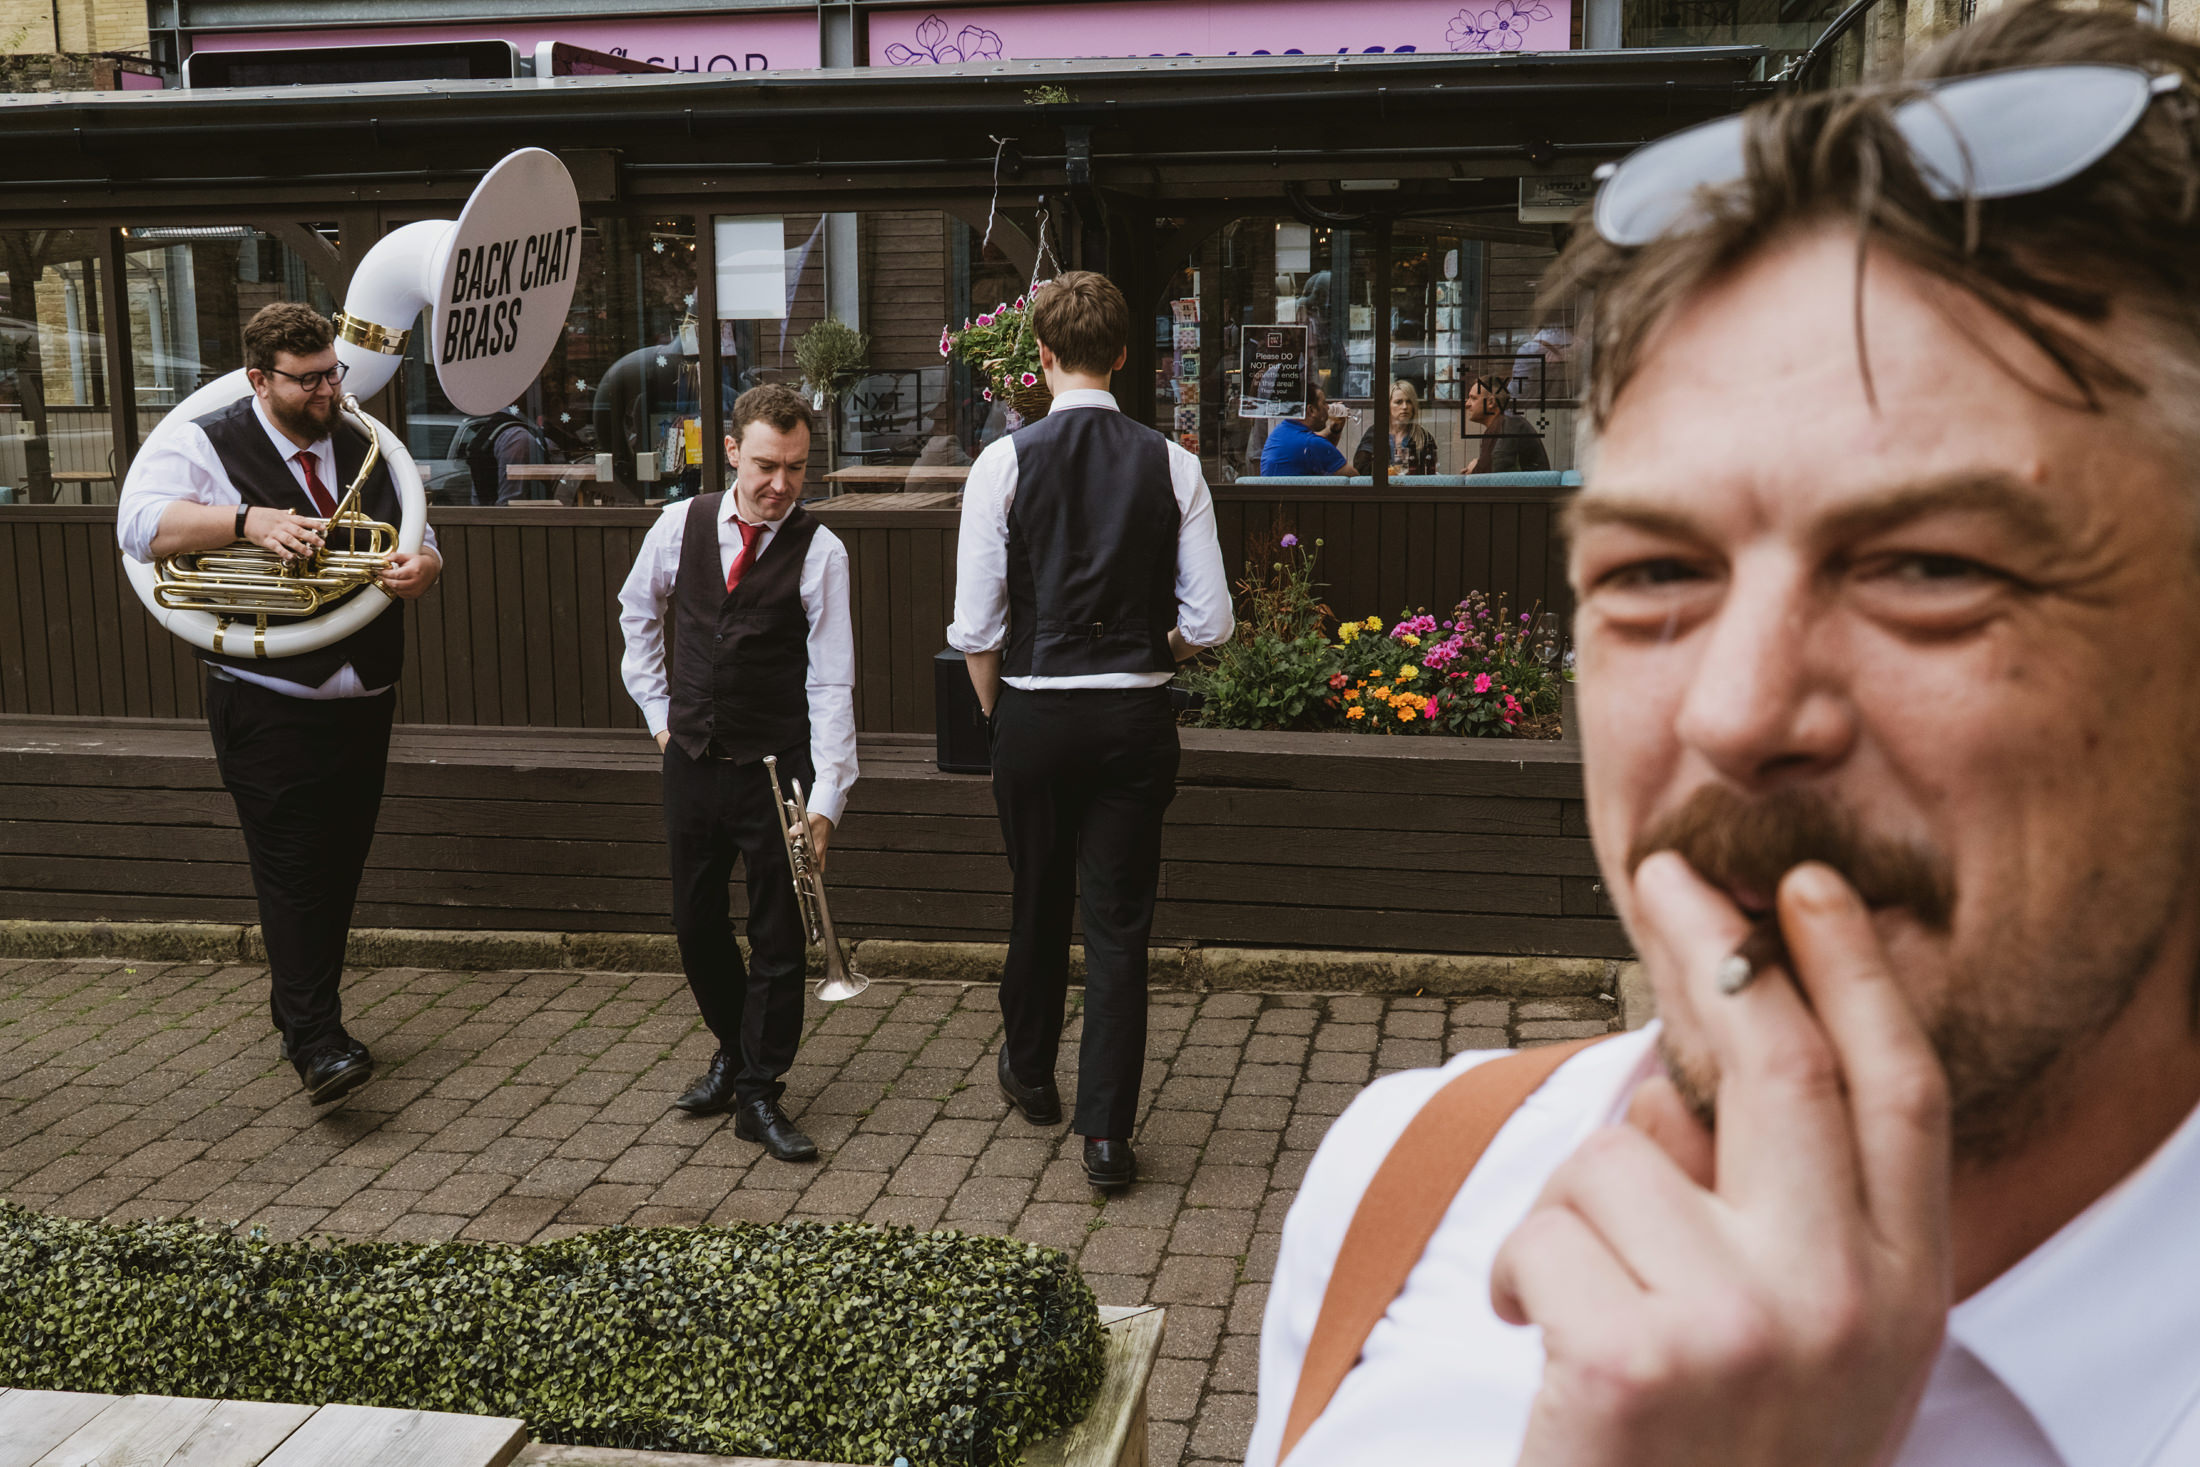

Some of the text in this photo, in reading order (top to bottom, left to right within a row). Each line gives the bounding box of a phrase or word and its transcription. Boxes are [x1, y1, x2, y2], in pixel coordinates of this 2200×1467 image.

[451, 226, 577, 304] BACK CHAT
[442, 297, 522, 365] BRASS
[1281, 363, 1298, 371] your
[1477, 377, 1528, 394] NXT
[853, 392, 904, 411] NXT
[1483, 398, 1524, 415] LVL
[860, 414, 901, 433] LVL
